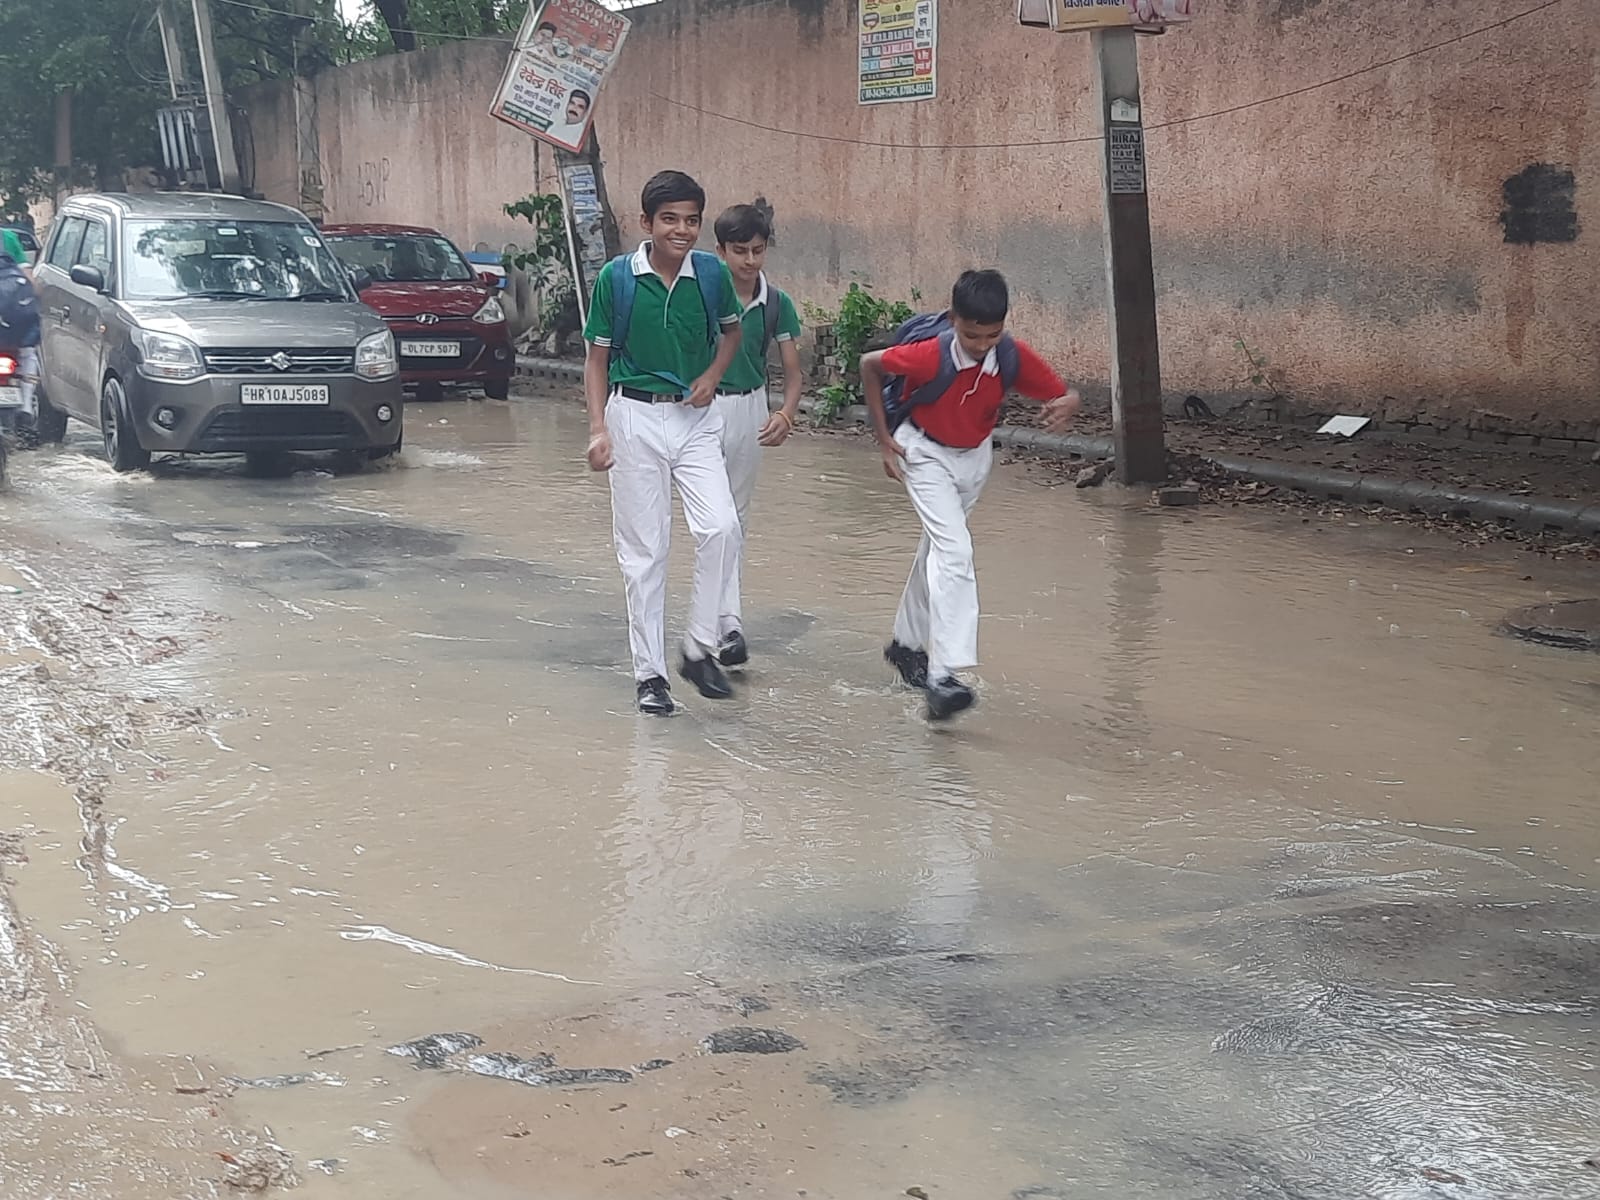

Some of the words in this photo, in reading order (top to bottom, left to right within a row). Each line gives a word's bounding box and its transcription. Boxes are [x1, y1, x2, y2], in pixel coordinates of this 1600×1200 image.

[545, 79, 567, 101] सिंह
[1112, 134, 1140, 144] NIRAJ
[437, 344, 458, 354] 5077
[250, 388, 326, 401] HR10AJ5089
